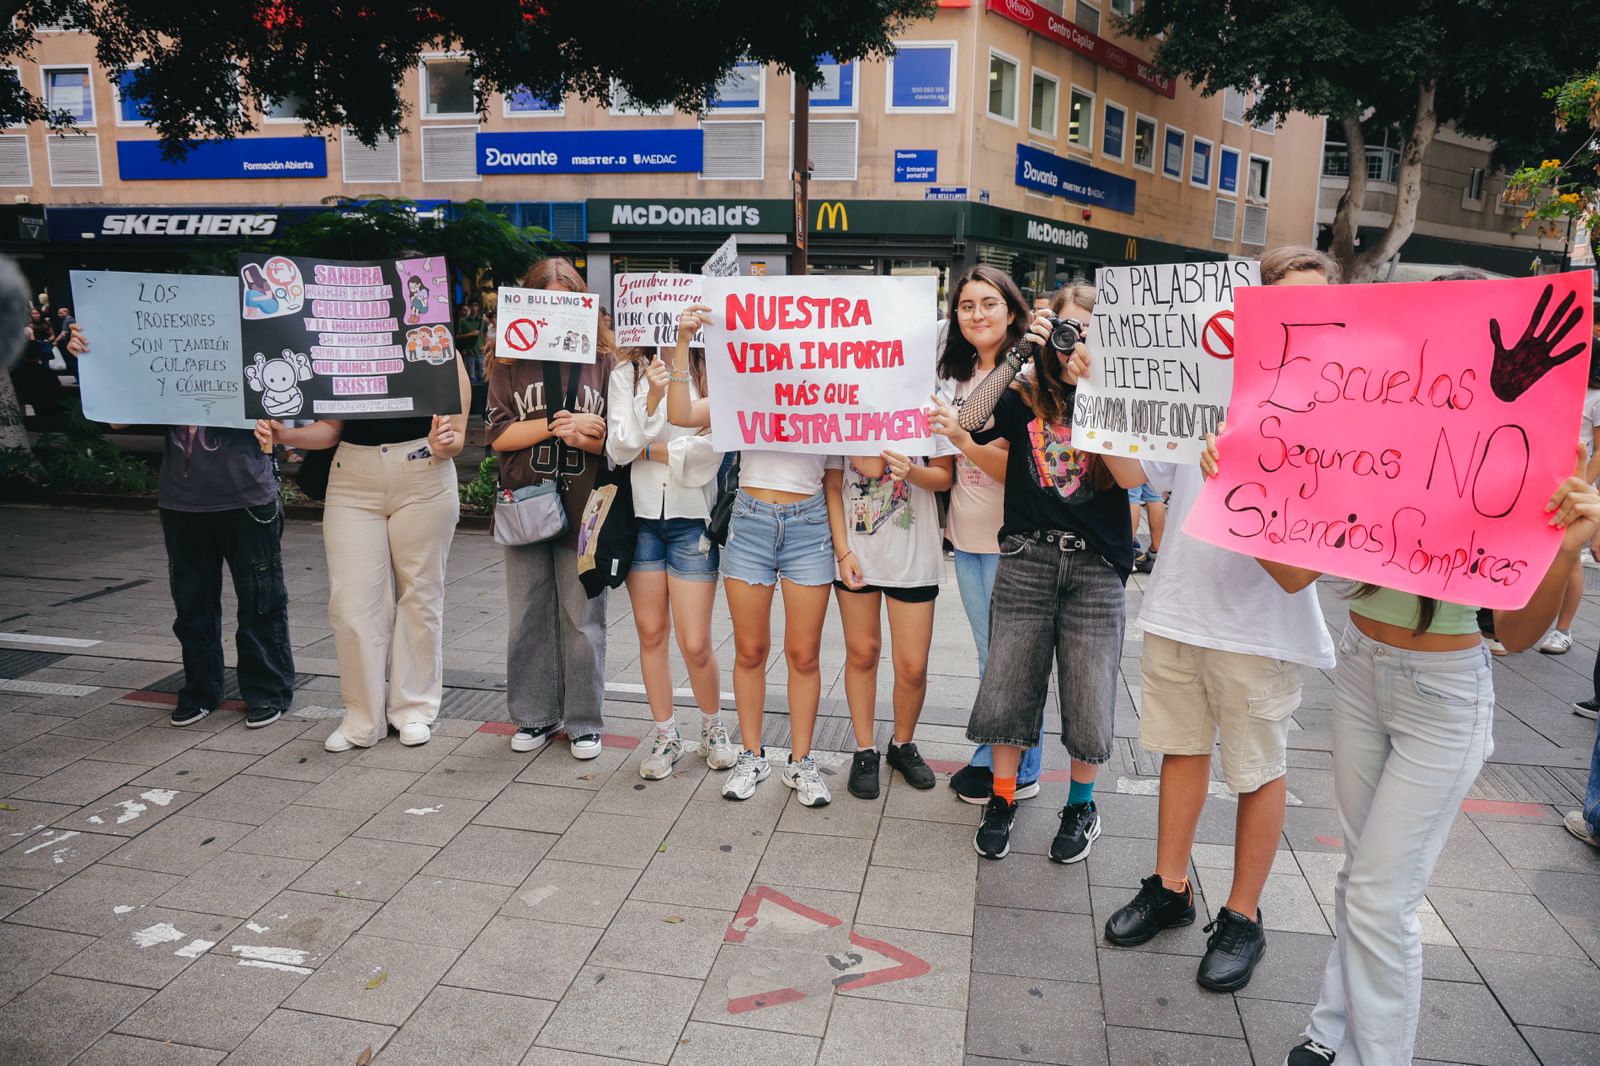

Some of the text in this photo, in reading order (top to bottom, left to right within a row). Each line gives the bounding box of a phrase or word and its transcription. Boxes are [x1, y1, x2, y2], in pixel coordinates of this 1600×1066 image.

[1048, 16, 1095, 50] Centro Capilar
[243, 160, 314, 171] Formación Abierta
[486, 147, 558, 166] Davante
[641, 154, 677, 165] MEDAC
[1024, 160, 1058, 187] Davante
[101, 214, 278, 235] SKECHERS
[611, 205, 760, 226] McDonald's
[1027, 220, 1089, 249] McDonald's
[314, 265, 383, 285] SANDRA
[618, 273, 693, 297] Sandra no
[1130, 261, 1251, 306] PALABRAS
[138, 281, 180, 304] LOS
[504, 294, 580, 306] NO BULLYING
[616, 291, 703, 308] es la primera
[312, 300, 389, 318] CRUELDAD
[617, 311, 645, 327] PERO
[647, 311, 672, 326] CON
[725, 293, 873, 331] NUESTRA
[135, 311, 216, 331] PROFESORES
[304, 318, 399, 331] Y LA INDIFERENCIA
[1093, 304, 1198, 348] TAMBIÉN
[129, 336, 229, 357] SON TAMBIÉN
[312, 347, 340, 359] SUMA
[344, 348, 351, 358] A
[726, 339, 905, 374] VIDA IMPORTA
[150, 356, 227, 373] CULPABLES
[313, 361, 335, 373] QUE
[338, 361, 373, 373] NUNCA
[1103, 356, 1200, 394] HIEREN
[1258, 322, 1476, 413] Escuelas
[157, 374, 239, 396] Y CÓMPLICES
[334, 376, 388, 394] EXISTIR
[774, 380, 859, 407] MÁS QUE
[1073, 393, 1128, 433] SANDRA
[736, 407, 932, 444] VUESTRA IMAGEN
[1258, 415, 1530, 519] Seguras NO
[1224, 481, 1383, 553] Silencios
